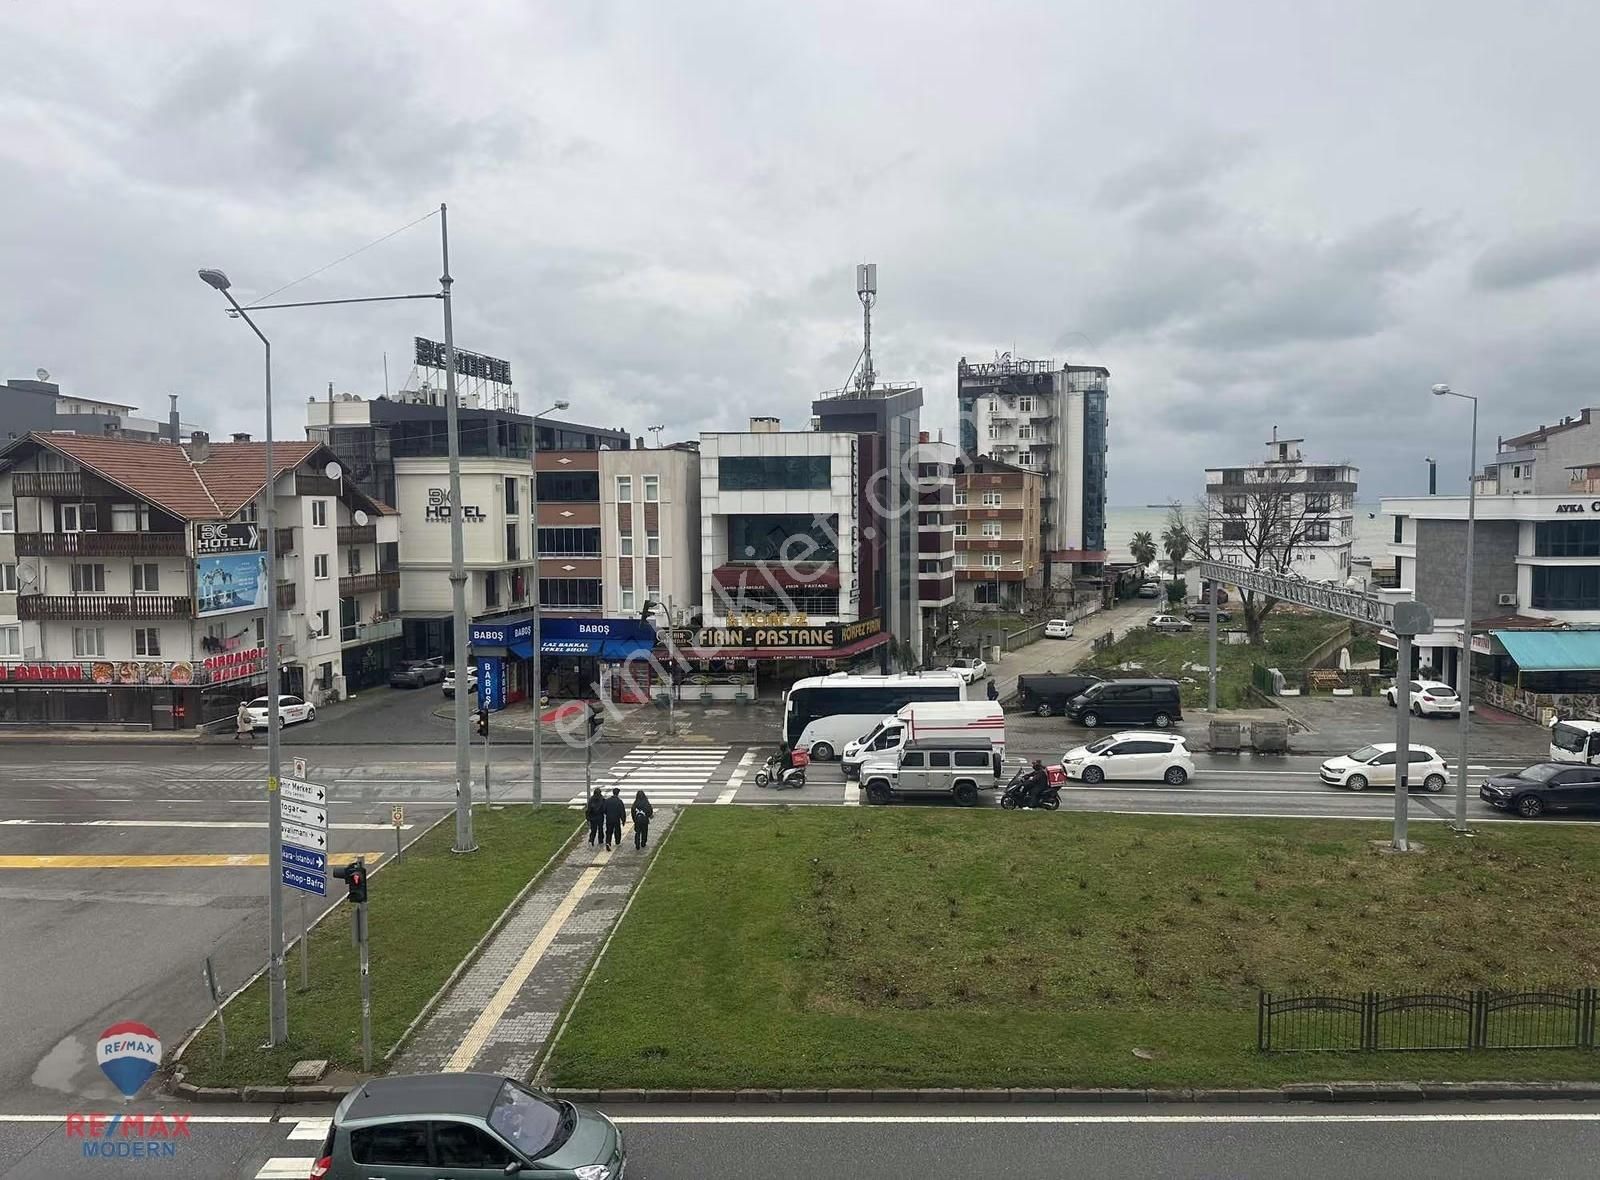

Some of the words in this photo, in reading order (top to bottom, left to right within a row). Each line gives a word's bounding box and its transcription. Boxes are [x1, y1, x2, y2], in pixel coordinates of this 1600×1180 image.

[426, 506, 487, 518] HOEL
[1556, 504, 1585, 513] AYKA
[198, 537, 249, 549] HOTEL
[515, 626, 532, 637] BABOŞ
[579, 624, 610, 635] BABOŞ
[473, 631, 504, 641] BABOŞ
[699, 629, 743, 646] FIRIN
[755, 629, 833, 646] PASTANE
[281, 802, 299, 813] togar
[281, 825, 309, 837] avalimanı
[285, 870, 324, 889] Sinop-Bafra
